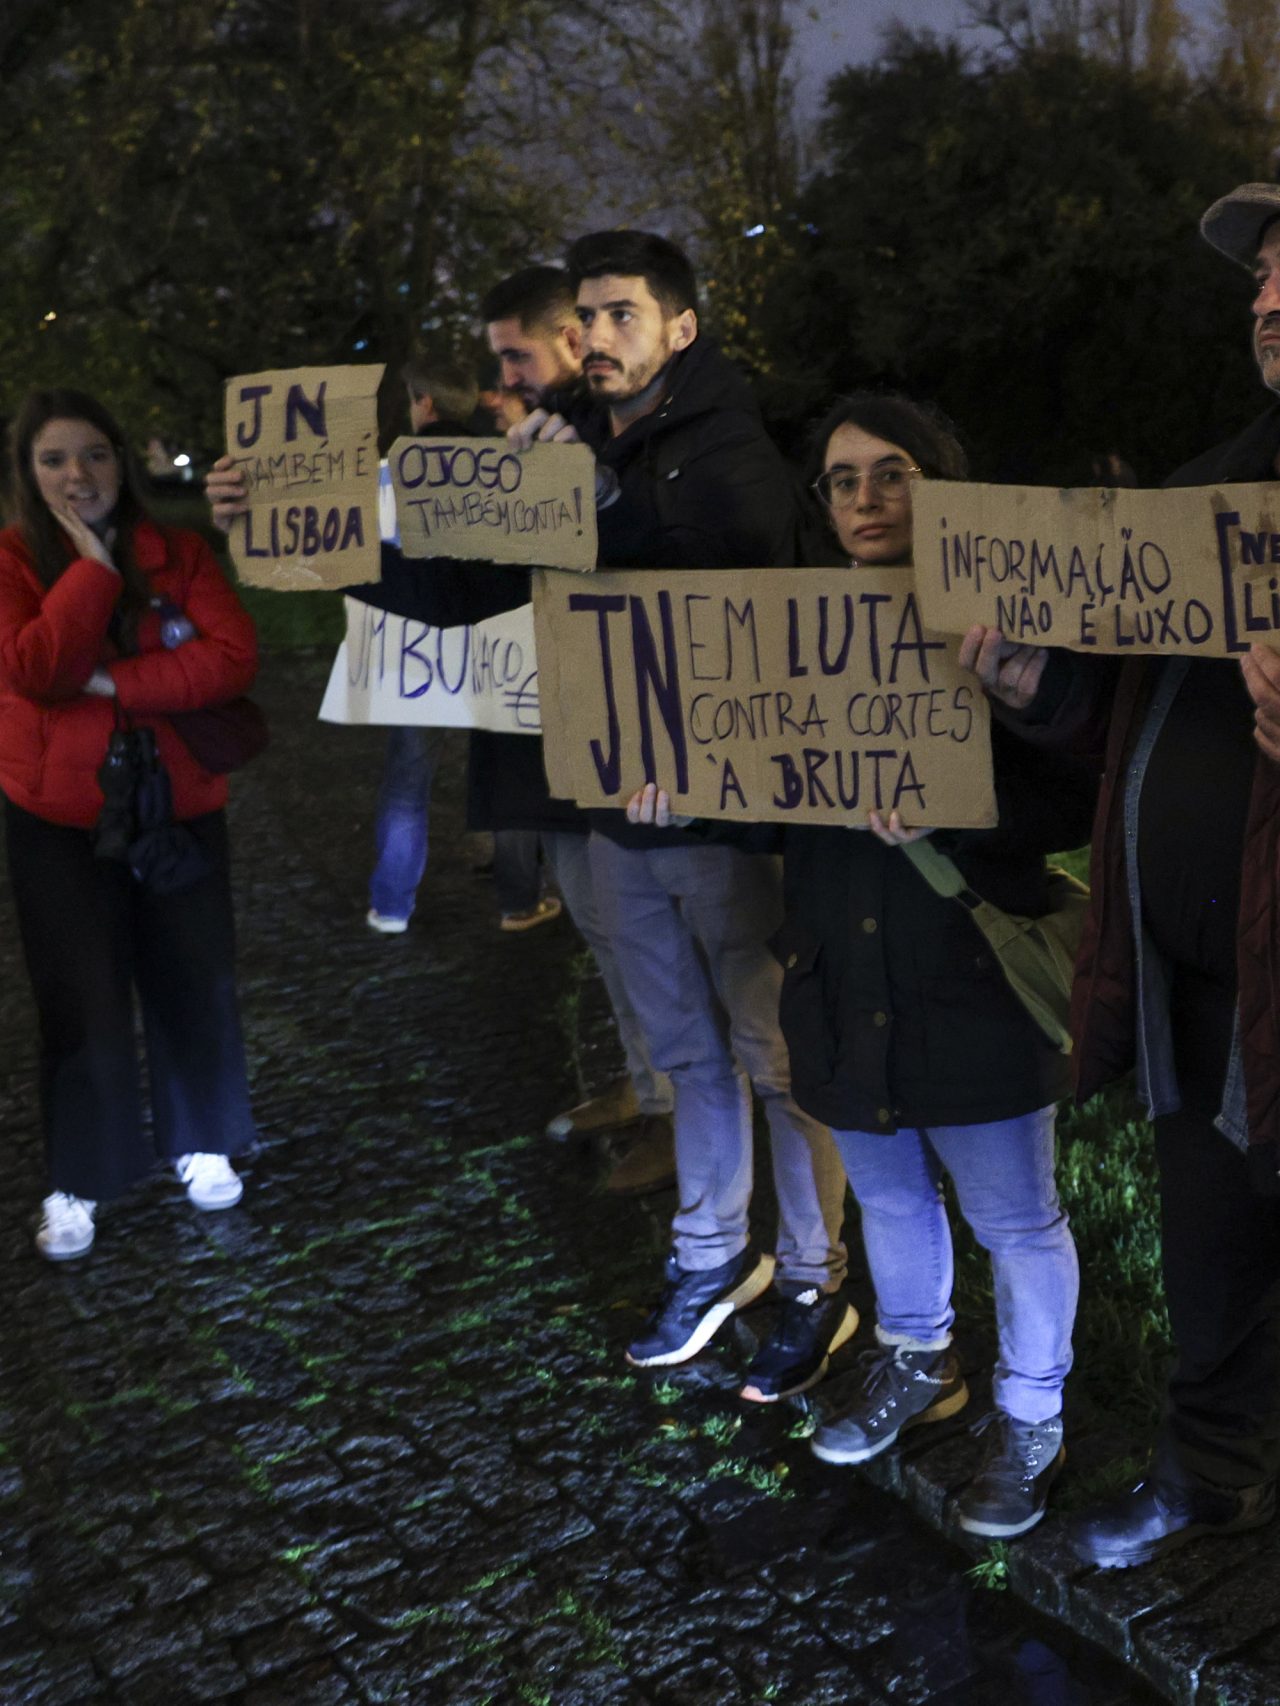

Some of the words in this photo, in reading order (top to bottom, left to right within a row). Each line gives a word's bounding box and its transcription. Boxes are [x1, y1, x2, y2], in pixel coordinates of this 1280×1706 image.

[236, 381, 328, 449] JN
[354, 433, 373, 477] É
[244, 506, 365, 559] LISBOA
[995, 585, 1053, 639] NÃO
[1114, 598, 1214, 648] LUXO
[568, 590, 690, 797] JN
[684, 594, 761, 684] EM
[788, 592, 948, 686] LUTA
[689, 690, 829, 745] CONTRA
[847, 685, 975, 744] CORTES
[770, 747, 926, 811] BRUTA
